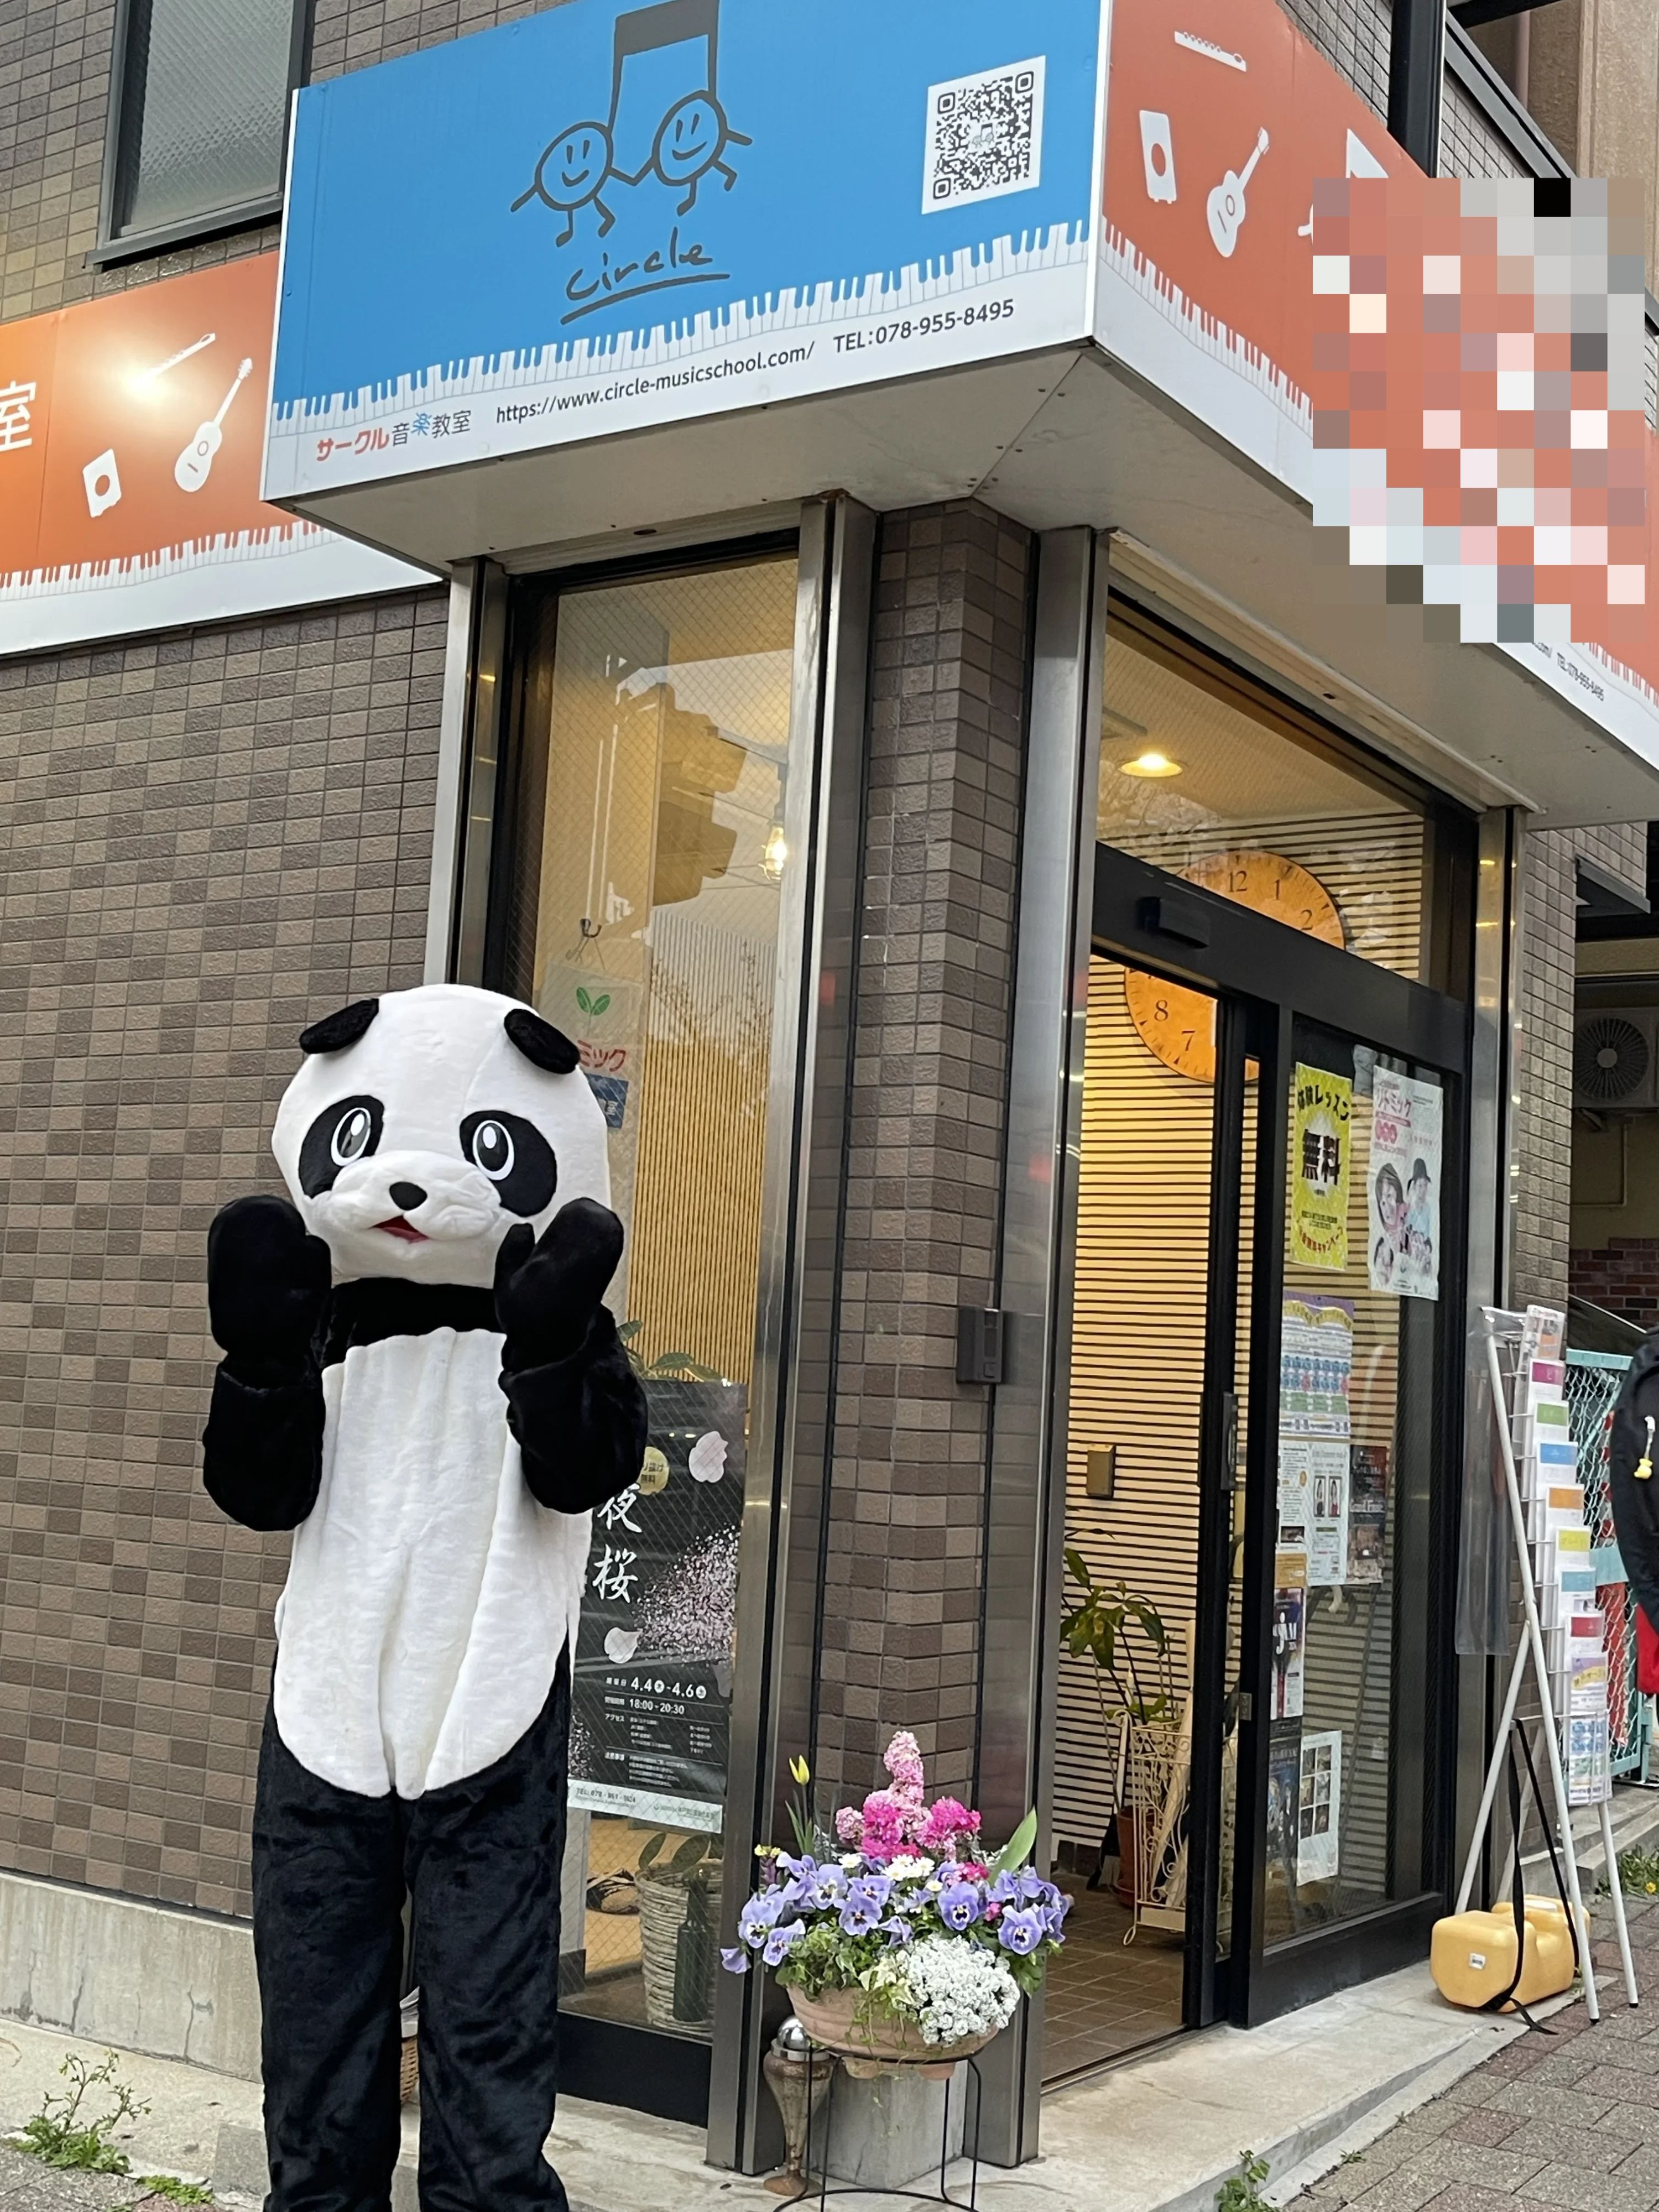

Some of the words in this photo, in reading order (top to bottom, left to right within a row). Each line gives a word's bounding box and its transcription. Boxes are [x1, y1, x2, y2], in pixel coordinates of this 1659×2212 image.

[566, 227, 713, 300] circle
[316, 410, 471, 462] サークル音楽教室
[496, 341, 815, 424] https://www.circle-musicschool.com/
[833, 299, 1014, 353] TEL:078-955-8495
[1227, 870, 1248, 893] 12
[1273, 880, 1281, 900] 1
[1301, 909, 1313, 931] 2
[1154, 999, 1169, 1021] 8
[1181, 1030, 1196, 1052] 7
[1302, 1129, 1341, 1186] 無料
